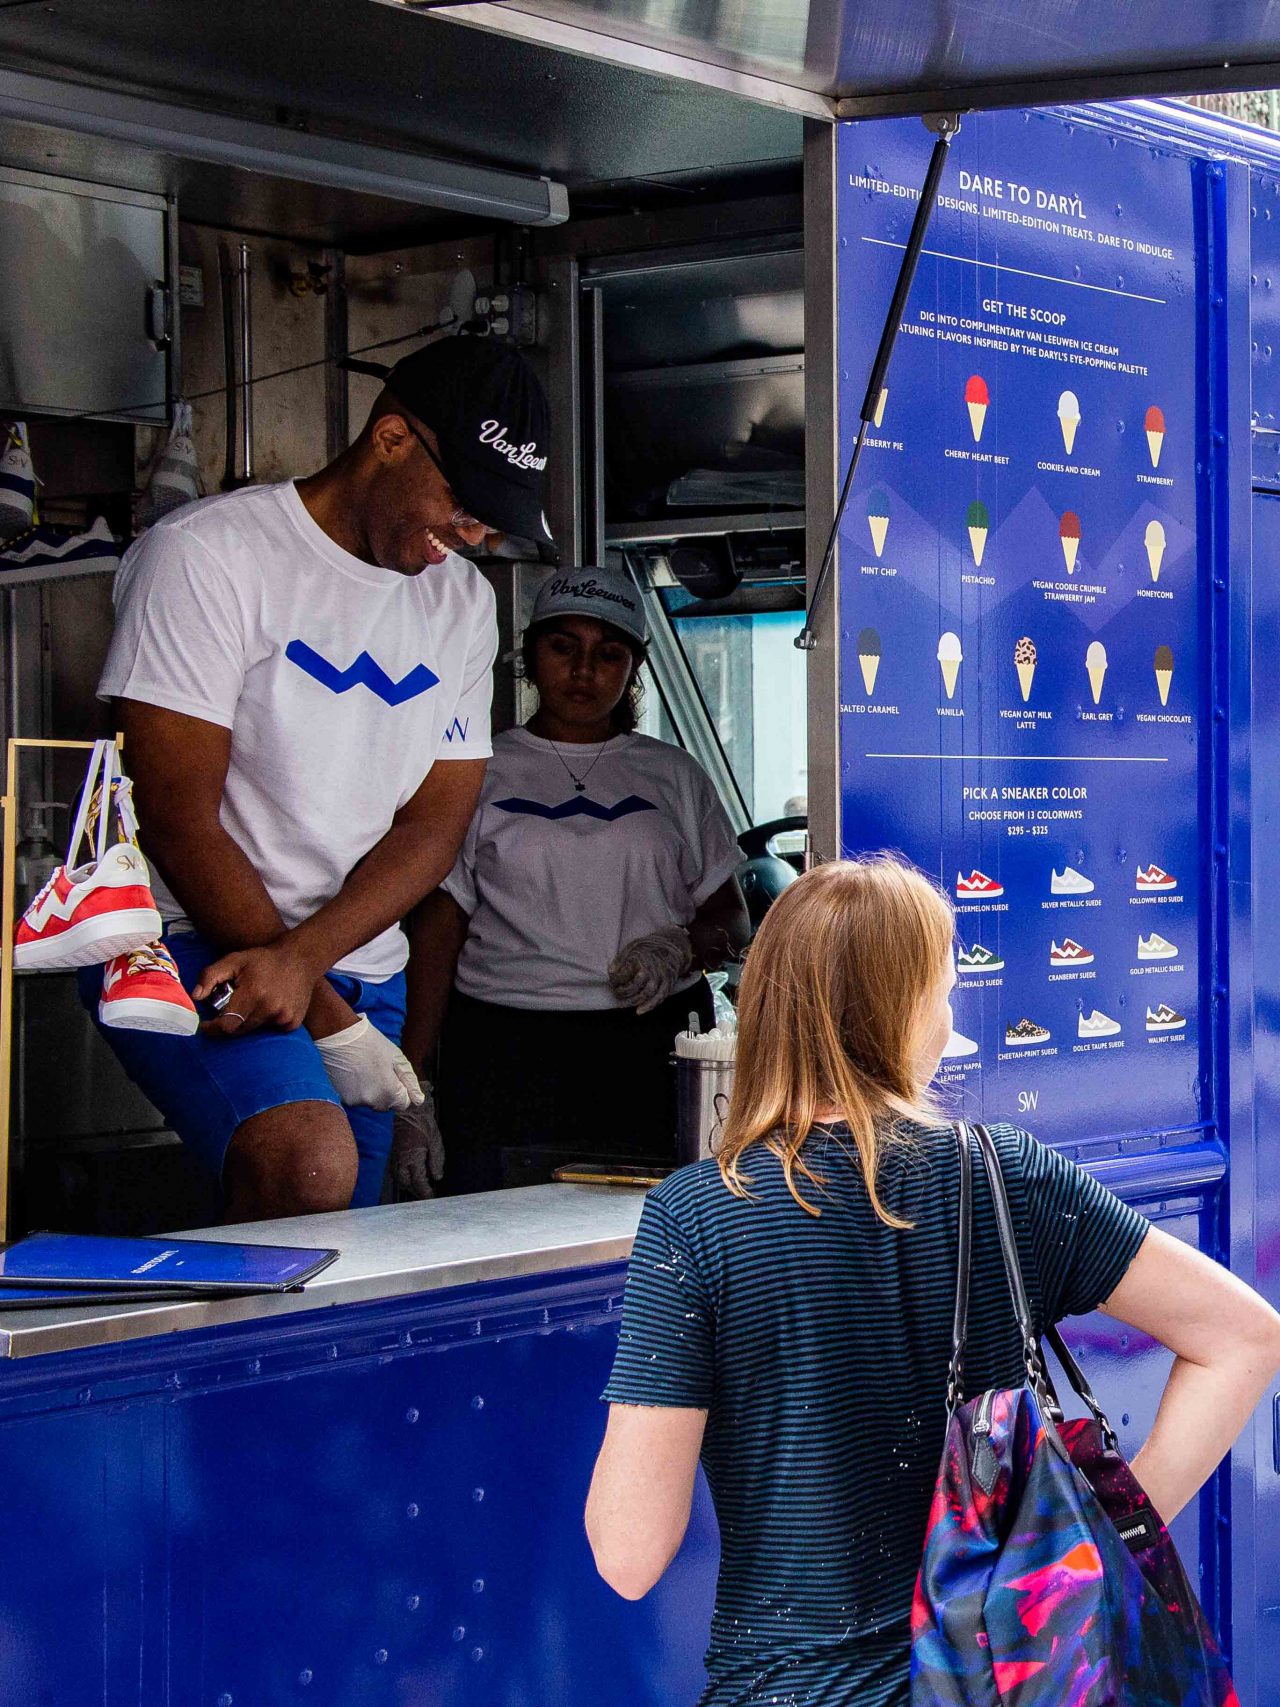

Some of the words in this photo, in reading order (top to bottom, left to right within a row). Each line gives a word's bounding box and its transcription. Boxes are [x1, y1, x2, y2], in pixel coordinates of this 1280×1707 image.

[960, 171, 1002, 198] DARE
[1008, 183, 1030, 204] TO
[1037, 190, 1086, 219] DARYL
[850, 175, 922, 200] LIMITED-EDITI
[938, 195, 980, 214] DESIGNS.
[983, 204, 1059, 233] LIMITED-EDITION
[1061, 224, 1095, 241] TREATS.
[1098, 233, 1120, 247] DARE
[1122, 239, 1134, 250] TO
[1137, 242, 1174, 260] INDULGE.
[983, 299, 1003, 313] GET
[1006, 304, 1027, 318] THE
[1031, 309, 1066, 325] SCOOP
[920, 311, 935, 321] DIG
[938, 314, 957, 326] INTO
[960, 318, 1025, 343] COMPLIMENTARY
[1026, 331, 1041, 342] VAN
[1044, 335, 1079, 348] LEEUWEN
[1081, 341, 1092, 351] ICE
[1095, 344, 1118, 356] CREAM
[899, 324, 934, 337] ATURING
[937, 330, 971, 344] FLAVORS
[974, 337, 1008, 350] INSPIRED
[1011, 344, 1020, 353] BY
[1022, 345, 1036, 356] THE
[1039, 349, 1067, 361] DARYL'S
[1070, 354, 1116, 370] EYE-POPPING
[1119, 363, 1147, 376] PALETTE
[479, 420, 518, 458] Van
[853, 434, 891, 448] BUEBERRY
[893, 442, 903, 450] PIE
[945, 449, 970, 459] CHERRY
[972, 453, 992, 462] HEART
[994, 456, 1009, 464] BEET
[1037, 462, 1064, 472] COOKIES
[1080, 468, 1100, 476] CREAM
[1137, 475, 1173, 486] STRAWBERRY
[861, 566, 878, 575] MINT
[881, 568, 897, 576] CHIP
[962, 575, 995, 585] PISTACHIO
[1033, 581, 1053, 589] VEGAN
[1055, 583, 1078, 591] COOKIE
[1080, 585, 1106, 594] CRUMBLE
[1045, 592, 1083, 602] STRAWBERRY
[1084, 596, 1095, 604] JAM
[1137, 589, 1173, 599] HONEYCOMB
[840, 705, 865, 713] SALTED
[868, 706, 899, 714] CARAMEL
[937, 708, 964, 716] VANILLA
[1000, 710, 1021, 718] VEGAN
[1157, 715, 1191, 723] CHOCOLATE
[964, 788, 988, 799] PICK
[991, 788, 998, 799] A
[1002, 788, 1048, 799] SNEAKER
[1052, 787, 1087, 799] COLOR
[969, 811, 1001, 820] CHOOSE
[1004, 811, 1024, 819] FROM
[1028, 811, 1034, 819] 13
[1037, 810, 1082, 819] COLORWAYS
[1008, 826, 1024, 836] $295
[1032, 826, 1048, 835] $325
[952, 905, 991, 914] WATERMELON
[1049, 973, 1078, 981] CRANBERRY
[958, 979, 985, 989] EMERALD
[1073, 1044, 1090, 1052] DOLCE
[998, 1050, 1040, 1060] CHEETAH-PRINT
[944, 1064, 962, 1073] SNOW
[963, 1062, 982, 1071] NAPPA
[940, 1073, 966, 1084] LEATHER
[1018, 1091, 1038, 1112] SW
